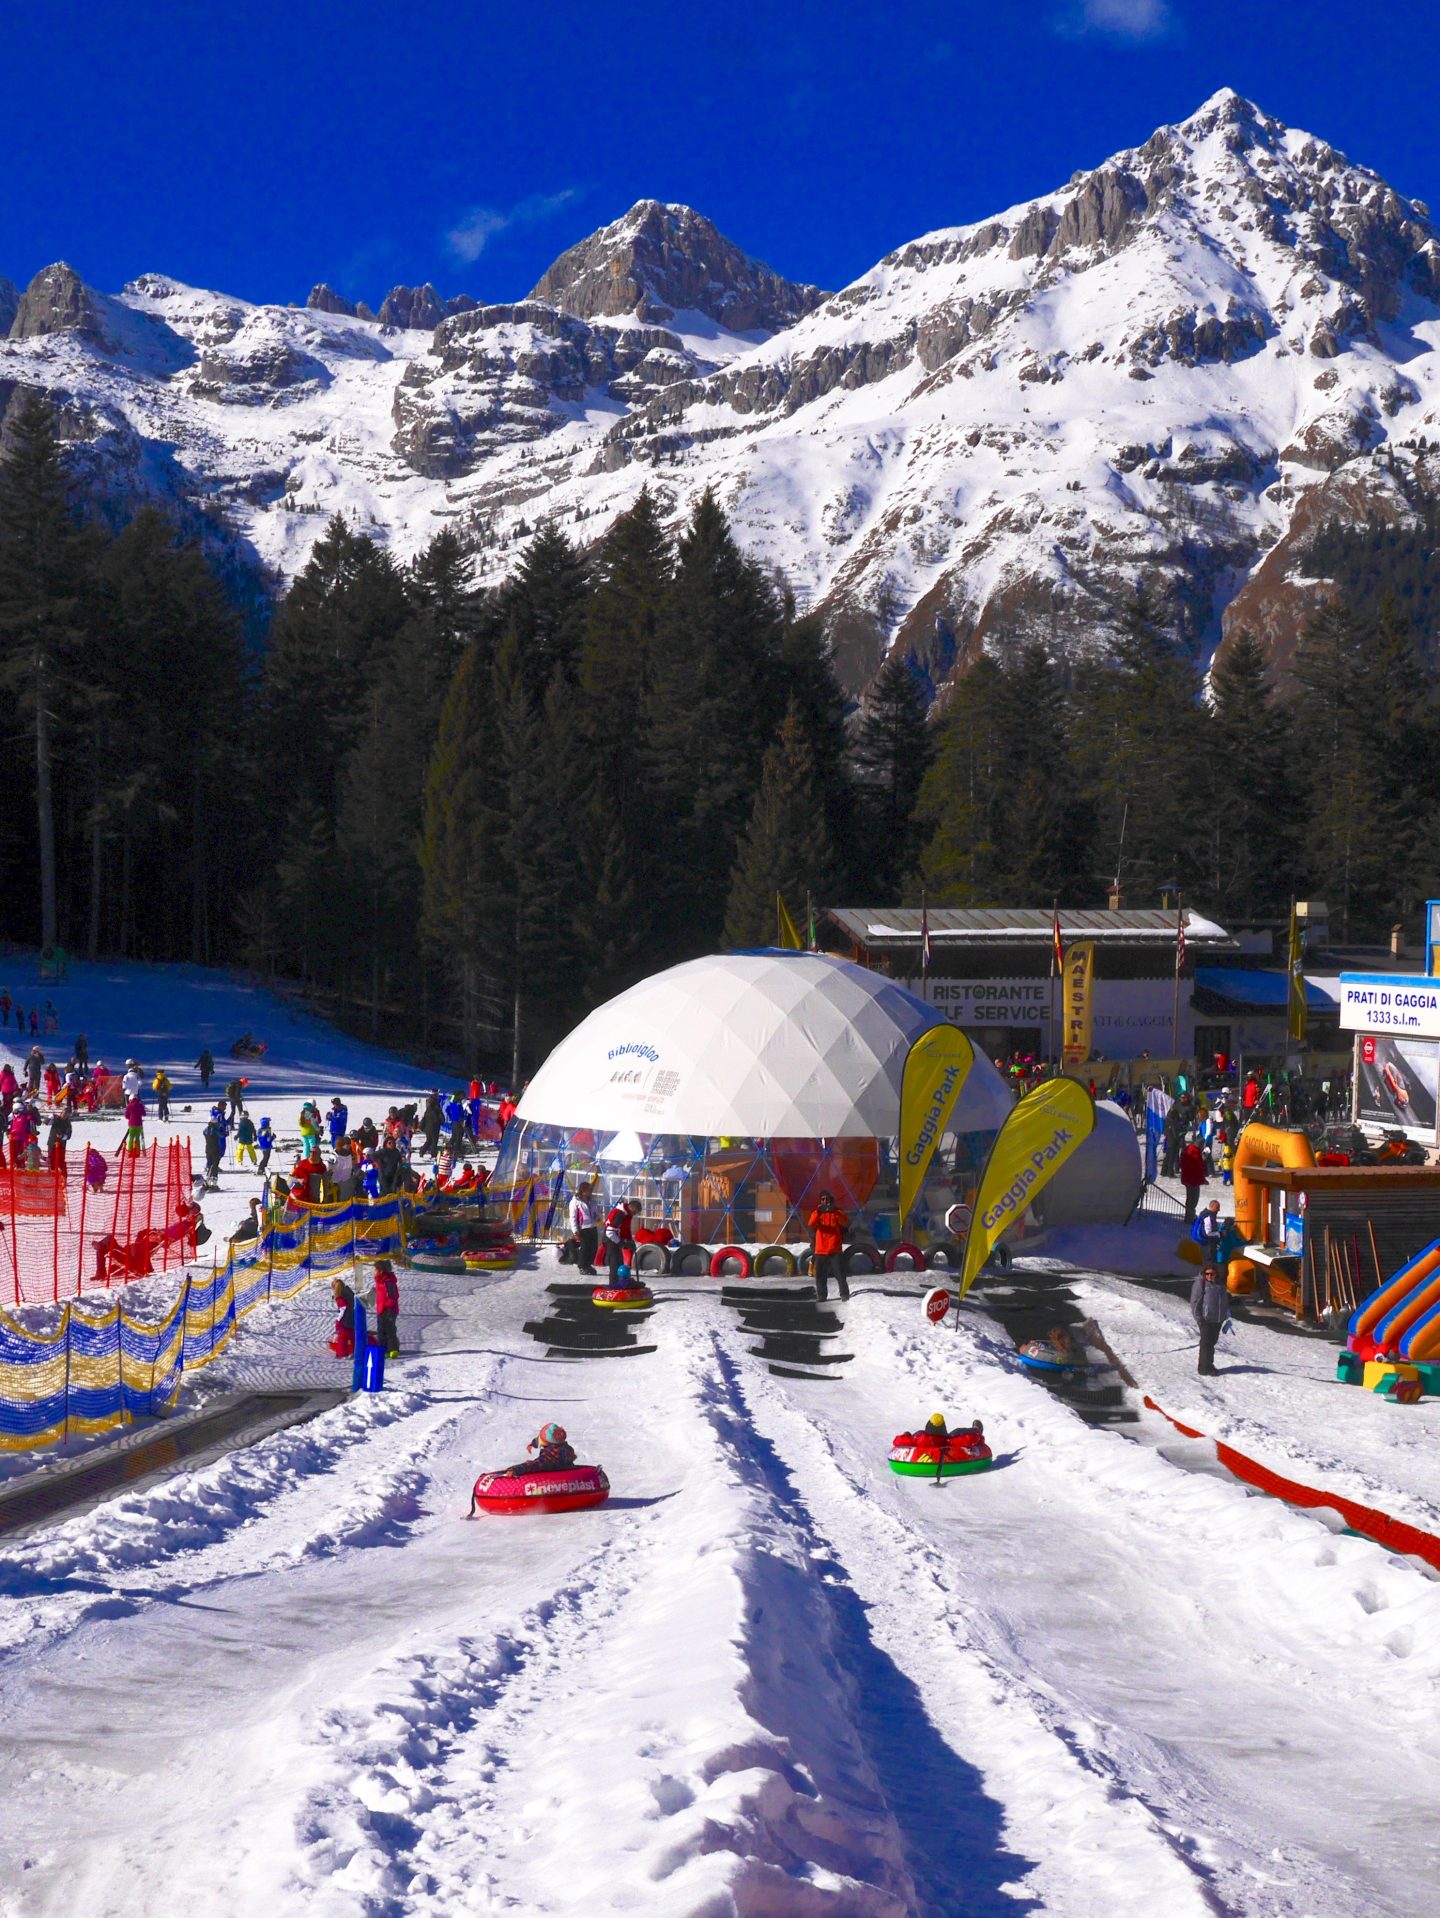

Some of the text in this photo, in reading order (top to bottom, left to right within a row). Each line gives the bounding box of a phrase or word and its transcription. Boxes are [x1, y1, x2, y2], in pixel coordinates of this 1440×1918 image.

[933, 985, 1044, 1000] RISTORANTE
[1071, 951, 1086, 1043] MAESTRI
[1347, 990, 1437, 1009] PRATI DI GAGGIA
[974, 1006, 1050, 1020] SERVICE
[1367, 1010, 1421, 1026] 1333 s.l.m.
[906, 1105, 942, 1166] Gaggia
[932, 1065, 960, 1105] Park
[980, 1168, 1037, 1231] Gaggia
[1031, 1127, 1073, 1171] Park
[928, 1296, 949, 1315] STOP
